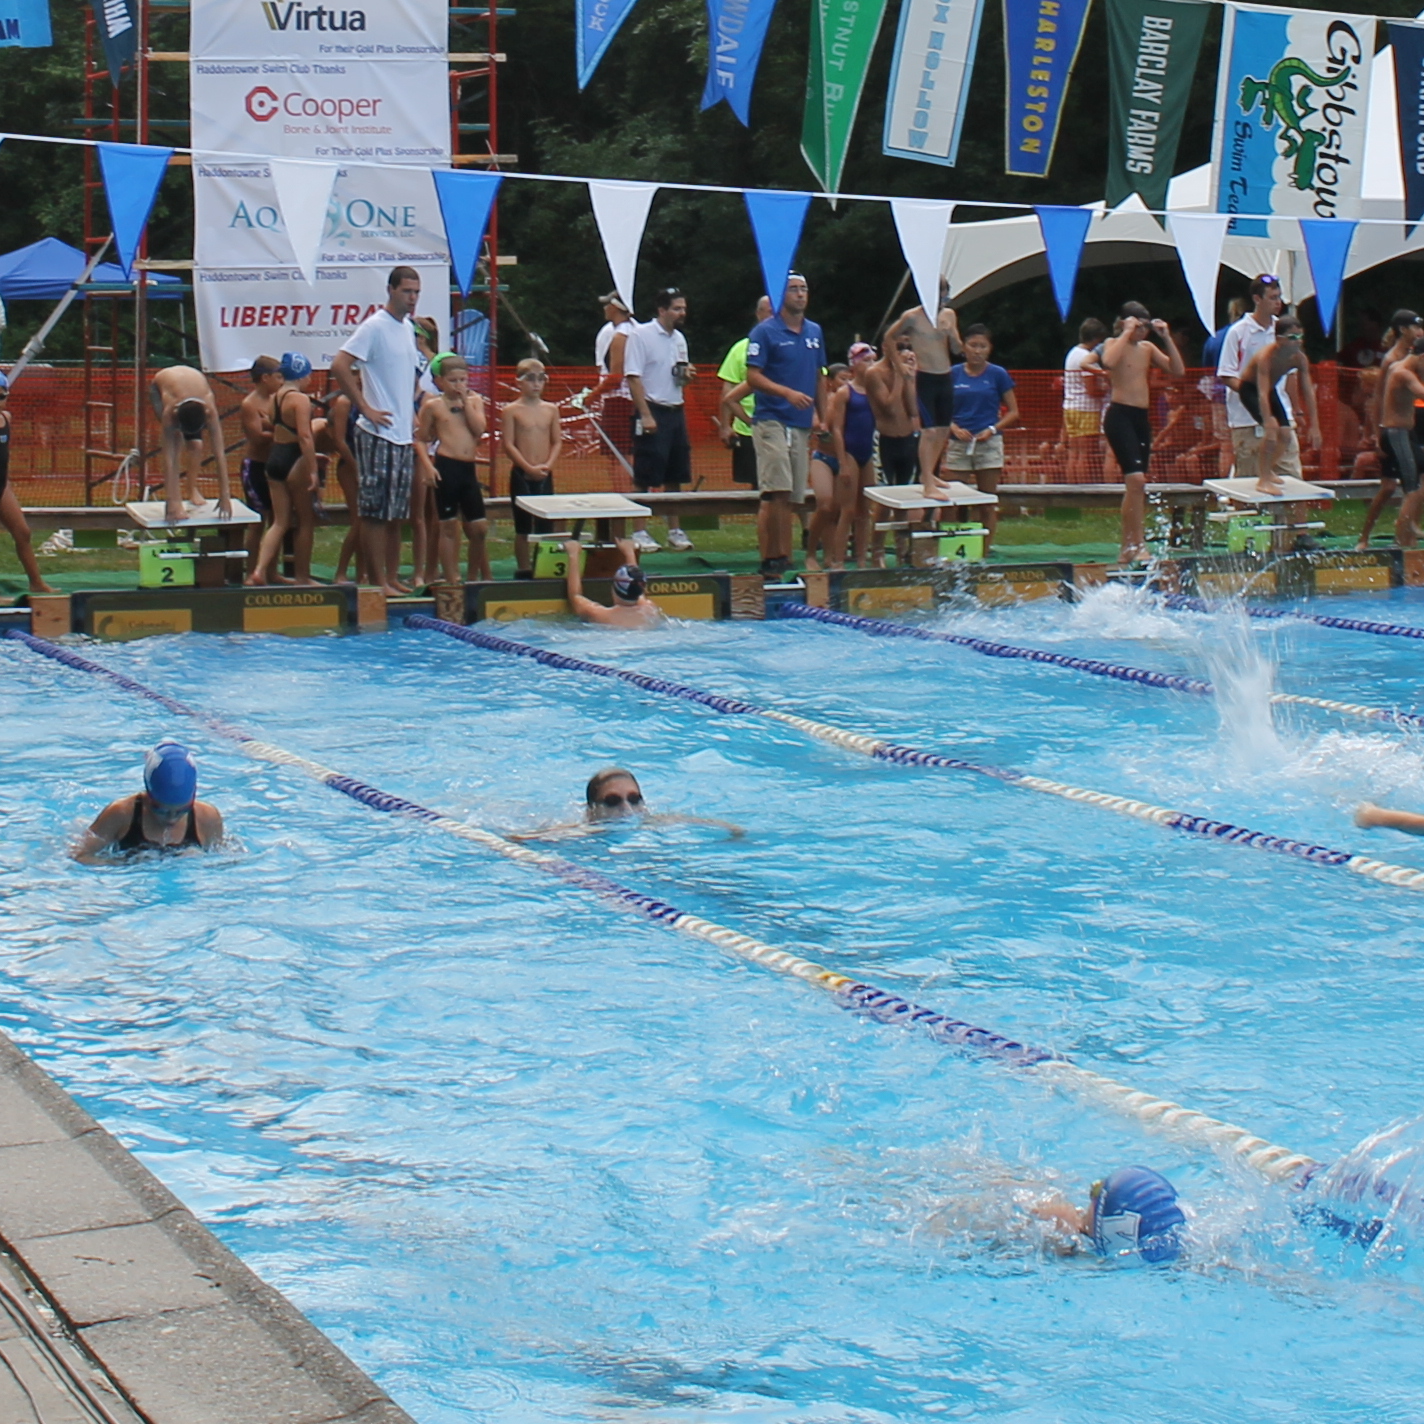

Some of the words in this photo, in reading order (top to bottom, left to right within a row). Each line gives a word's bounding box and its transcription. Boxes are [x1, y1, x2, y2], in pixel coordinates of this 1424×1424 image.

[261, 0, 366, 32] Virtua
[319, 44, 332, 54] For
[356, 44, 374, 55] Gold
[376, 44, 394, 54] Plus
[1131, 14, 1173, 105] BARCLAY
[262, 64, 287, 74] Swim
[290, 64, 310, 74] Club
[313, 64, 346, 75] Thanks
[907, 31, 946, 150] HOLLOW
[283, 92, 383, 124] Cooper
[284, 125, 310, 135] Bone
[313, 125, 322, 134] &
[323, 125, 349, 135] Joint
[351, 125, 392, 135] Institute
[1126, 108, 1160, 175] FARMS
[1231, 121, 1254, 175] Swim
[315, 147, 329, 156] For
[375, 147, 392, 156] Plus
[1226, 177, 1250, 230] Team
[378, 252, 395, 262] Plus
[264, 270, 289, 281] Swim
[220, 304, 320, 328] LIBERTY
[289, 328, 339, 338] America's
[955, 544, 966, 559] 4
[162, 566, 175, 583] 2
[553, 562, 565, 577] 3
[245, 594, 325, 606] COLORADO
